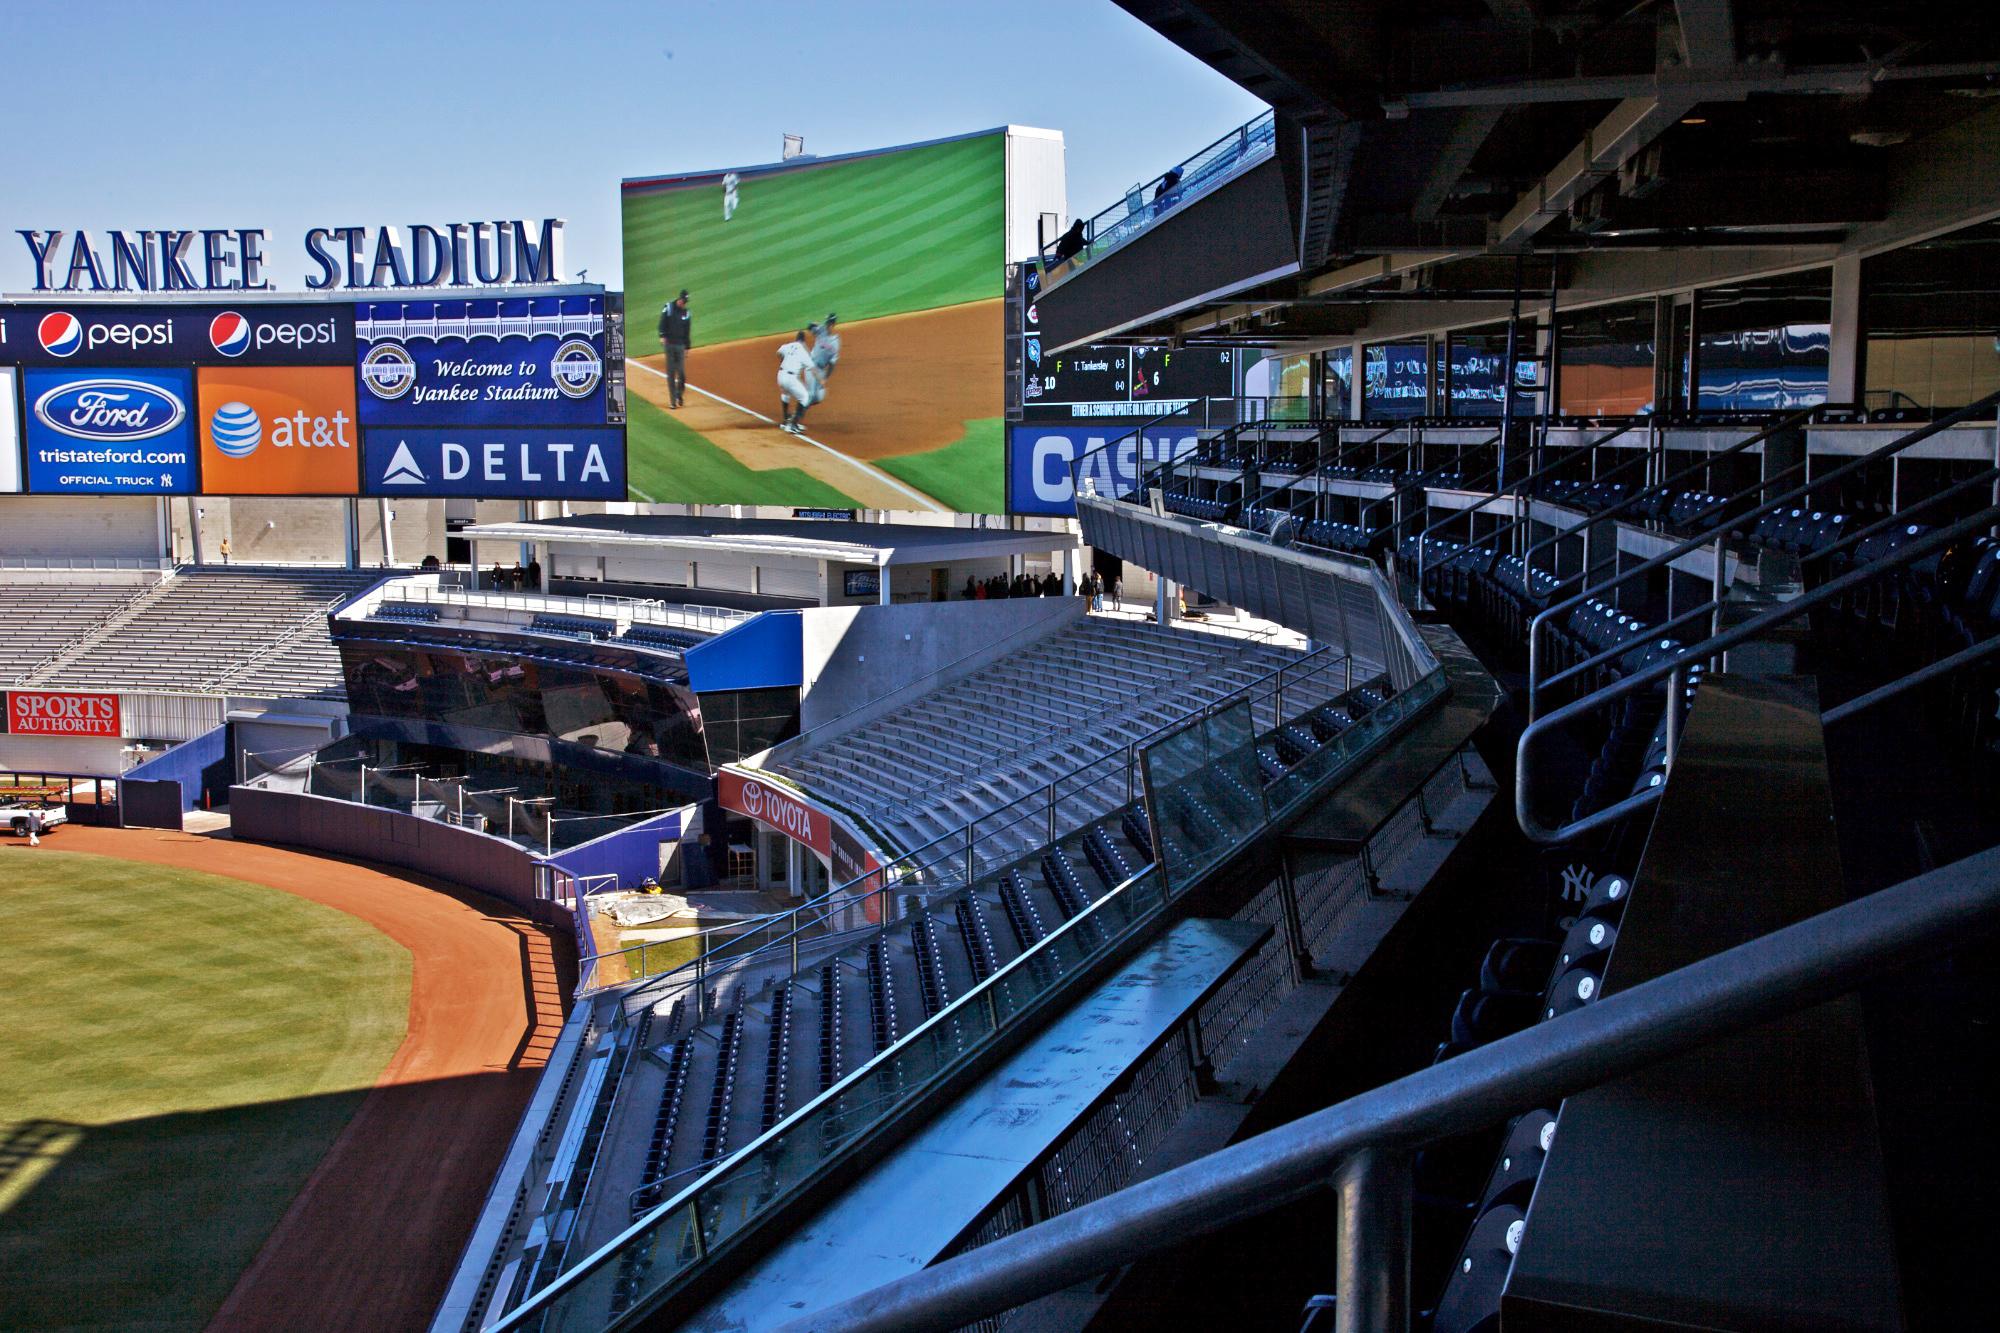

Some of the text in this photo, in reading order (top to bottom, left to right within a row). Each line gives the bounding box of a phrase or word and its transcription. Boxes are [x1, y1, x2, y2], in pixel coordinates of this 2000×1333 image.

[15, 218, 566, 292] YANKEE STADIUM
[88, 318, 173, 350] pepsi
[256, 318, 336, 350] pepsi
[1115, 358, 1125, 369] 0-3
[1164, 354, 1171, 367] F
[1220, 352, 1230, 364] 0-2
[433, 359, 537, 377] Welcome to
[1056, 361, 1062, 373] F
[1044, 376, 1056, 390] 10
[1115, 380, 1125, 391] 0-0
[1153, 371, 1160, 386] 6
[412, 382, 560, 405] Yankee Stadium
[70, 391, 150, 427] Ford
[1072, 404, 1089, 417] EITHER
[272, 410, 350, 448] at&t
[39, 448, 186, 464] tristateford.com
[442, 443, 611, 483] DELTA
[59, 475, 155, 487] OFFICIAL TRUCK
[16, 695, 114, 719] SPORTS
[18, 717, 114, 733] AUTHORITY
[763, 789, 812, 841] TOYOTA
